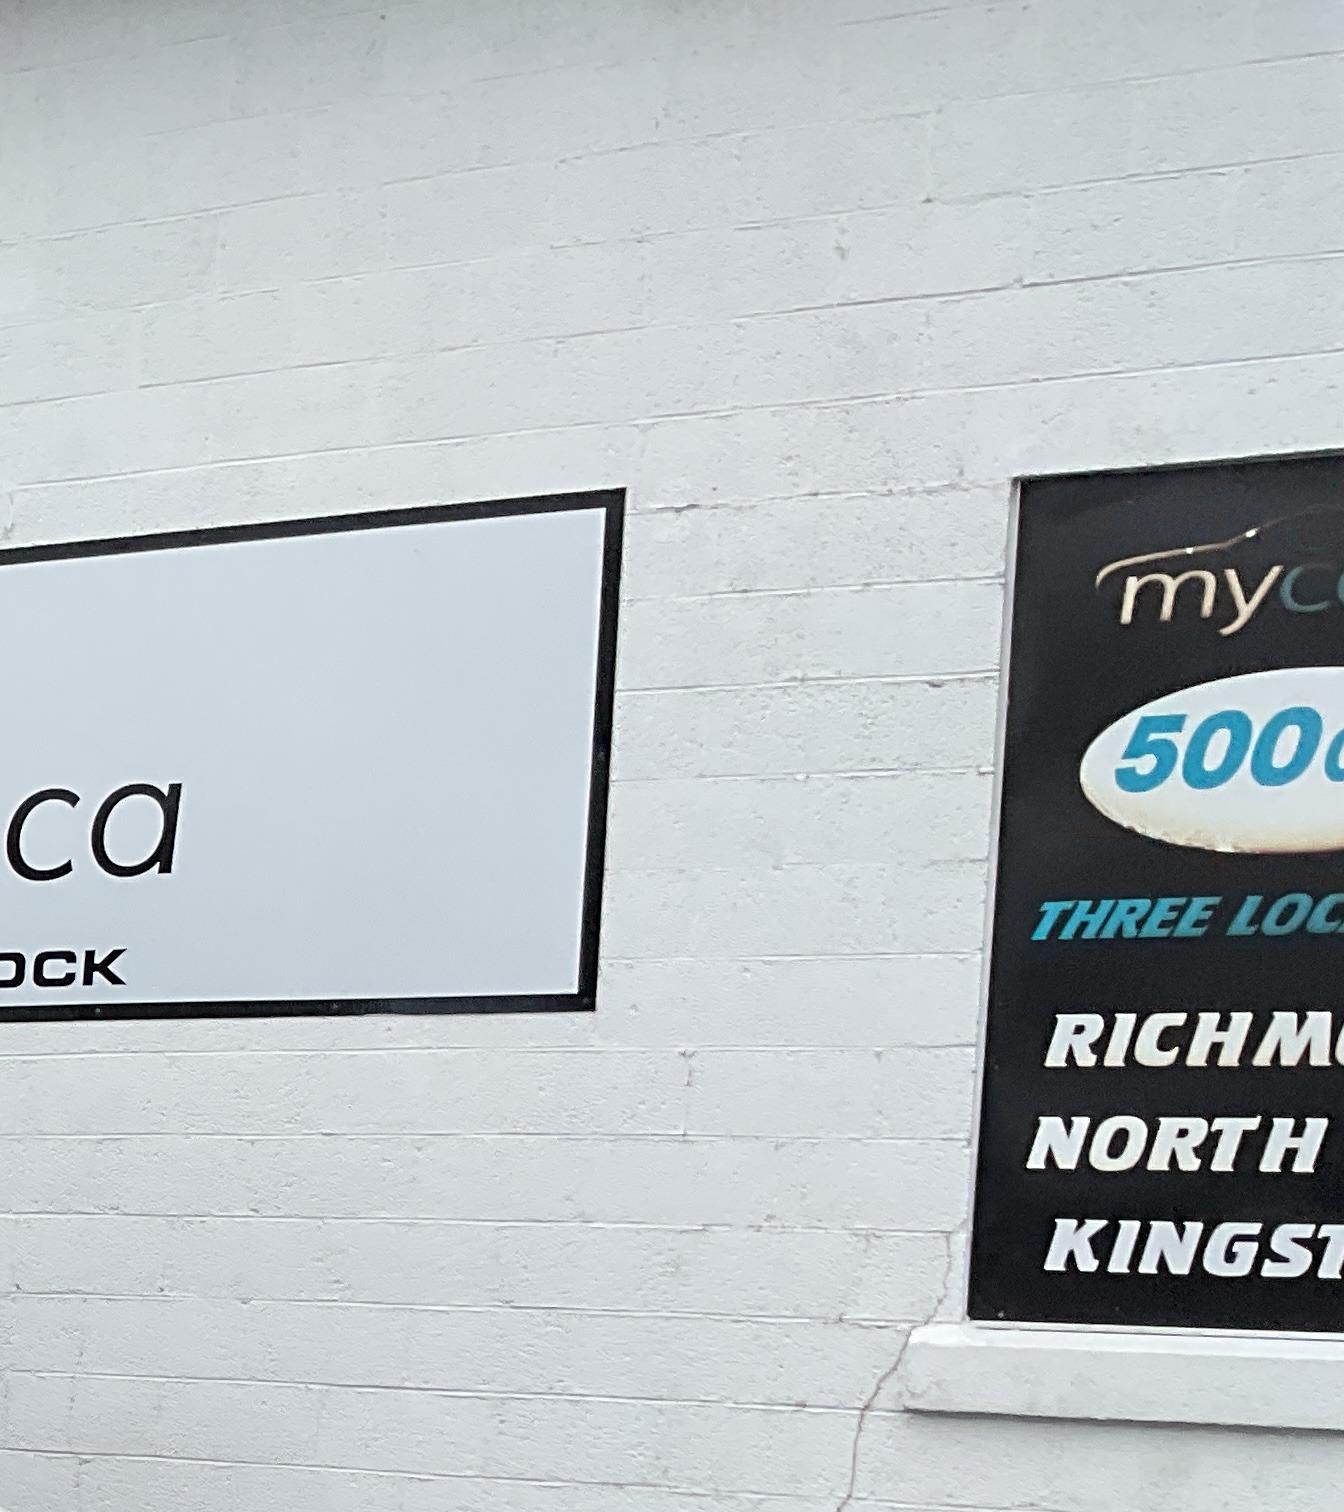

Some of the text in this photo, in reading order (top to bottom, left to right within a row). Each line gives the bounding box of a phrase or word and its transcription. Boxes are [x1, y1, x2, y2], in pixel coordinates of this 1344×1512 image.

[1120, 564, 1344, 636] myc
[1030, 892, 1344, 941] THREE LOC
[1043, 1010, 1344, 1068] RICHM
[1026, 1115, 1329, 1173] NORTH
